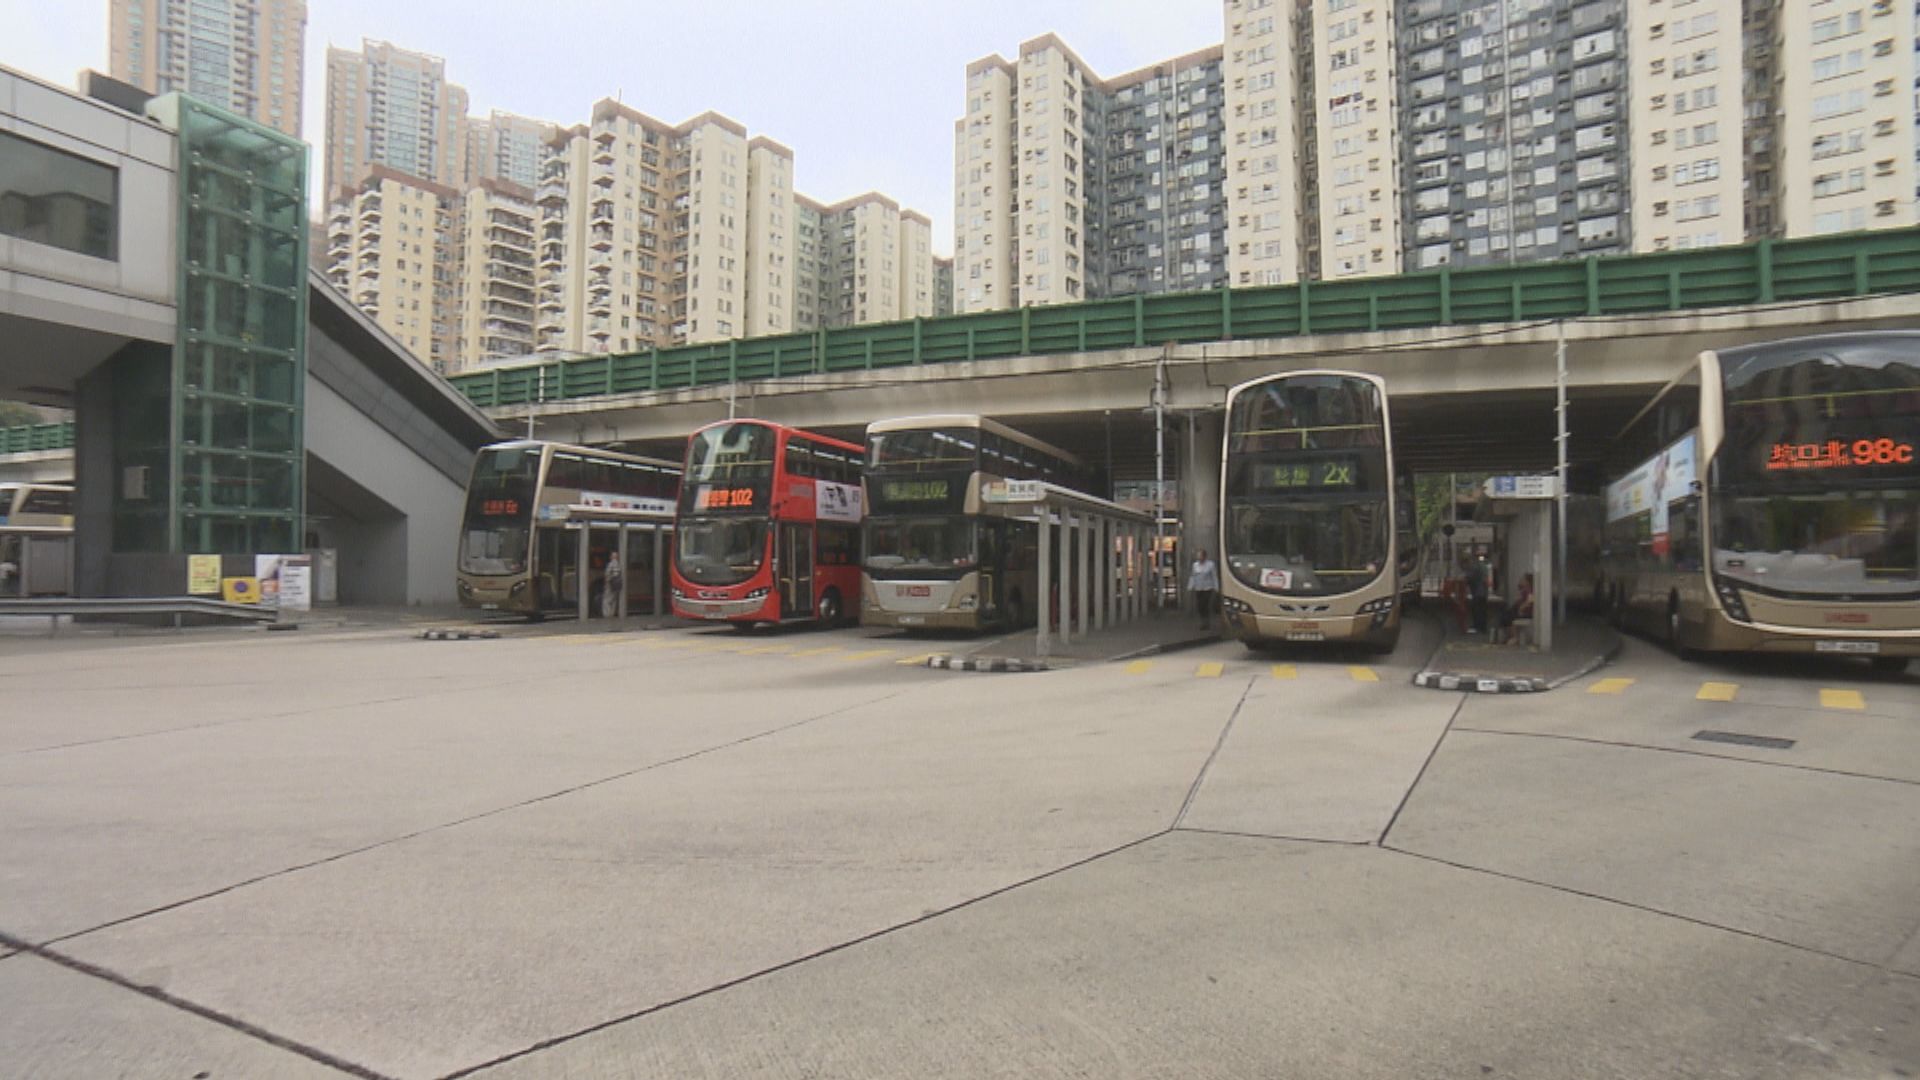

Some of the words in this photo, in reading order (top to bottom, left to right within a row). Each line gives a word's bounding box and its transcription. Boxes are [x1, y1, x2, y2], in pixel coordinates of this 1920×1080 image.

[1770, 441, 1848, 460] 坑口北
[1852, 438, 1913, 465] 98c
[1323, 462, 1352, 485] 2x
[730, 488, 753, 506] 102
